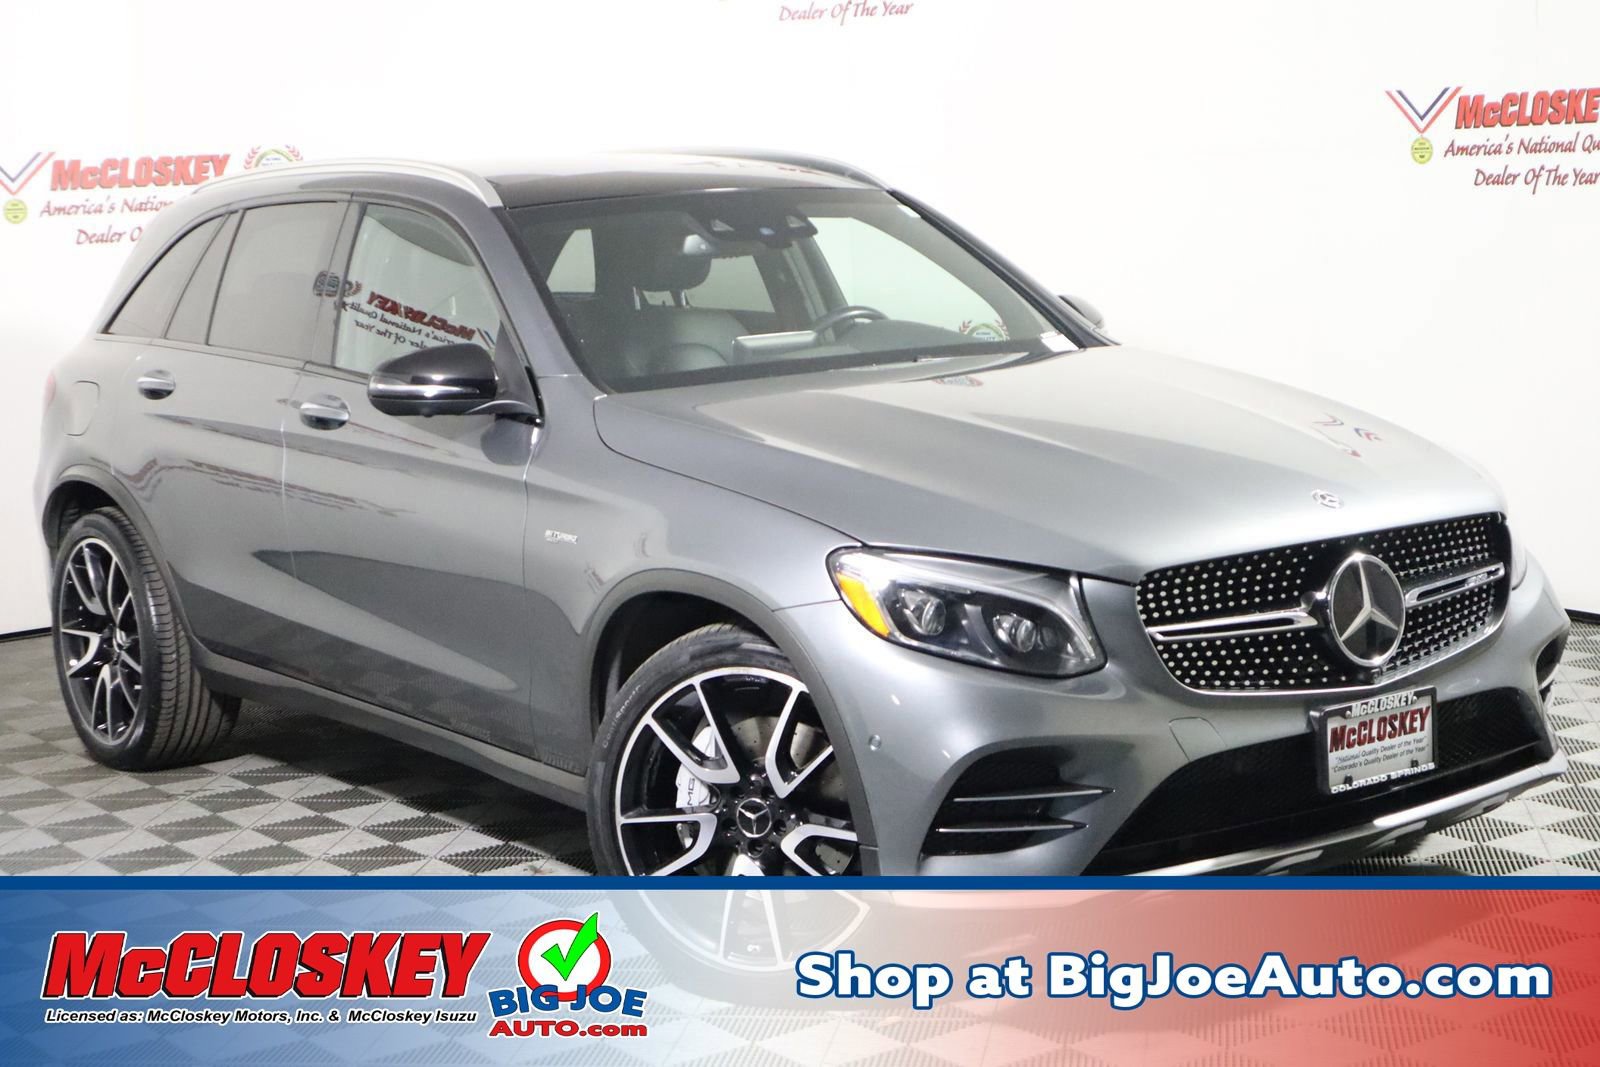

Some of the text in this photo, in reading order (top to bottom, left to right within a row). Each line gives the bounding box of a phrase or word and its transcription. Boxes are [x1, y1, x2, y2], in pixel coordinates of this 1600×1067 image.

[778, 0, 914, 26] Dealer Of The Year
[1454, 87, 1600, 130] McCLOSKE
[1444, 133, 1514, 158] America's
[1517, 131, 1580, 155] National
[50, 153, 230, 191] McCLOSKEY
[1474, 164, 1600, 195] Dealer Of The Year
[40, 195, 116, 218] America's
[76, 225, 144, 245] Dealer O
[1351, 691, 1415, 718] McCLOSKEY
[1329, 705, 1431, 753] McCLOSKEY
[1380, 743, 1396, 753] Dealer
[1397, 742, 1404, 750] of
[1382, 751, 1399, 762] Dealer
[1399, 749, 1406, 757] of
[1406, 747, 1414, 755] the
[1330, 762, 1436, 794] COLORADO SPRINGS
